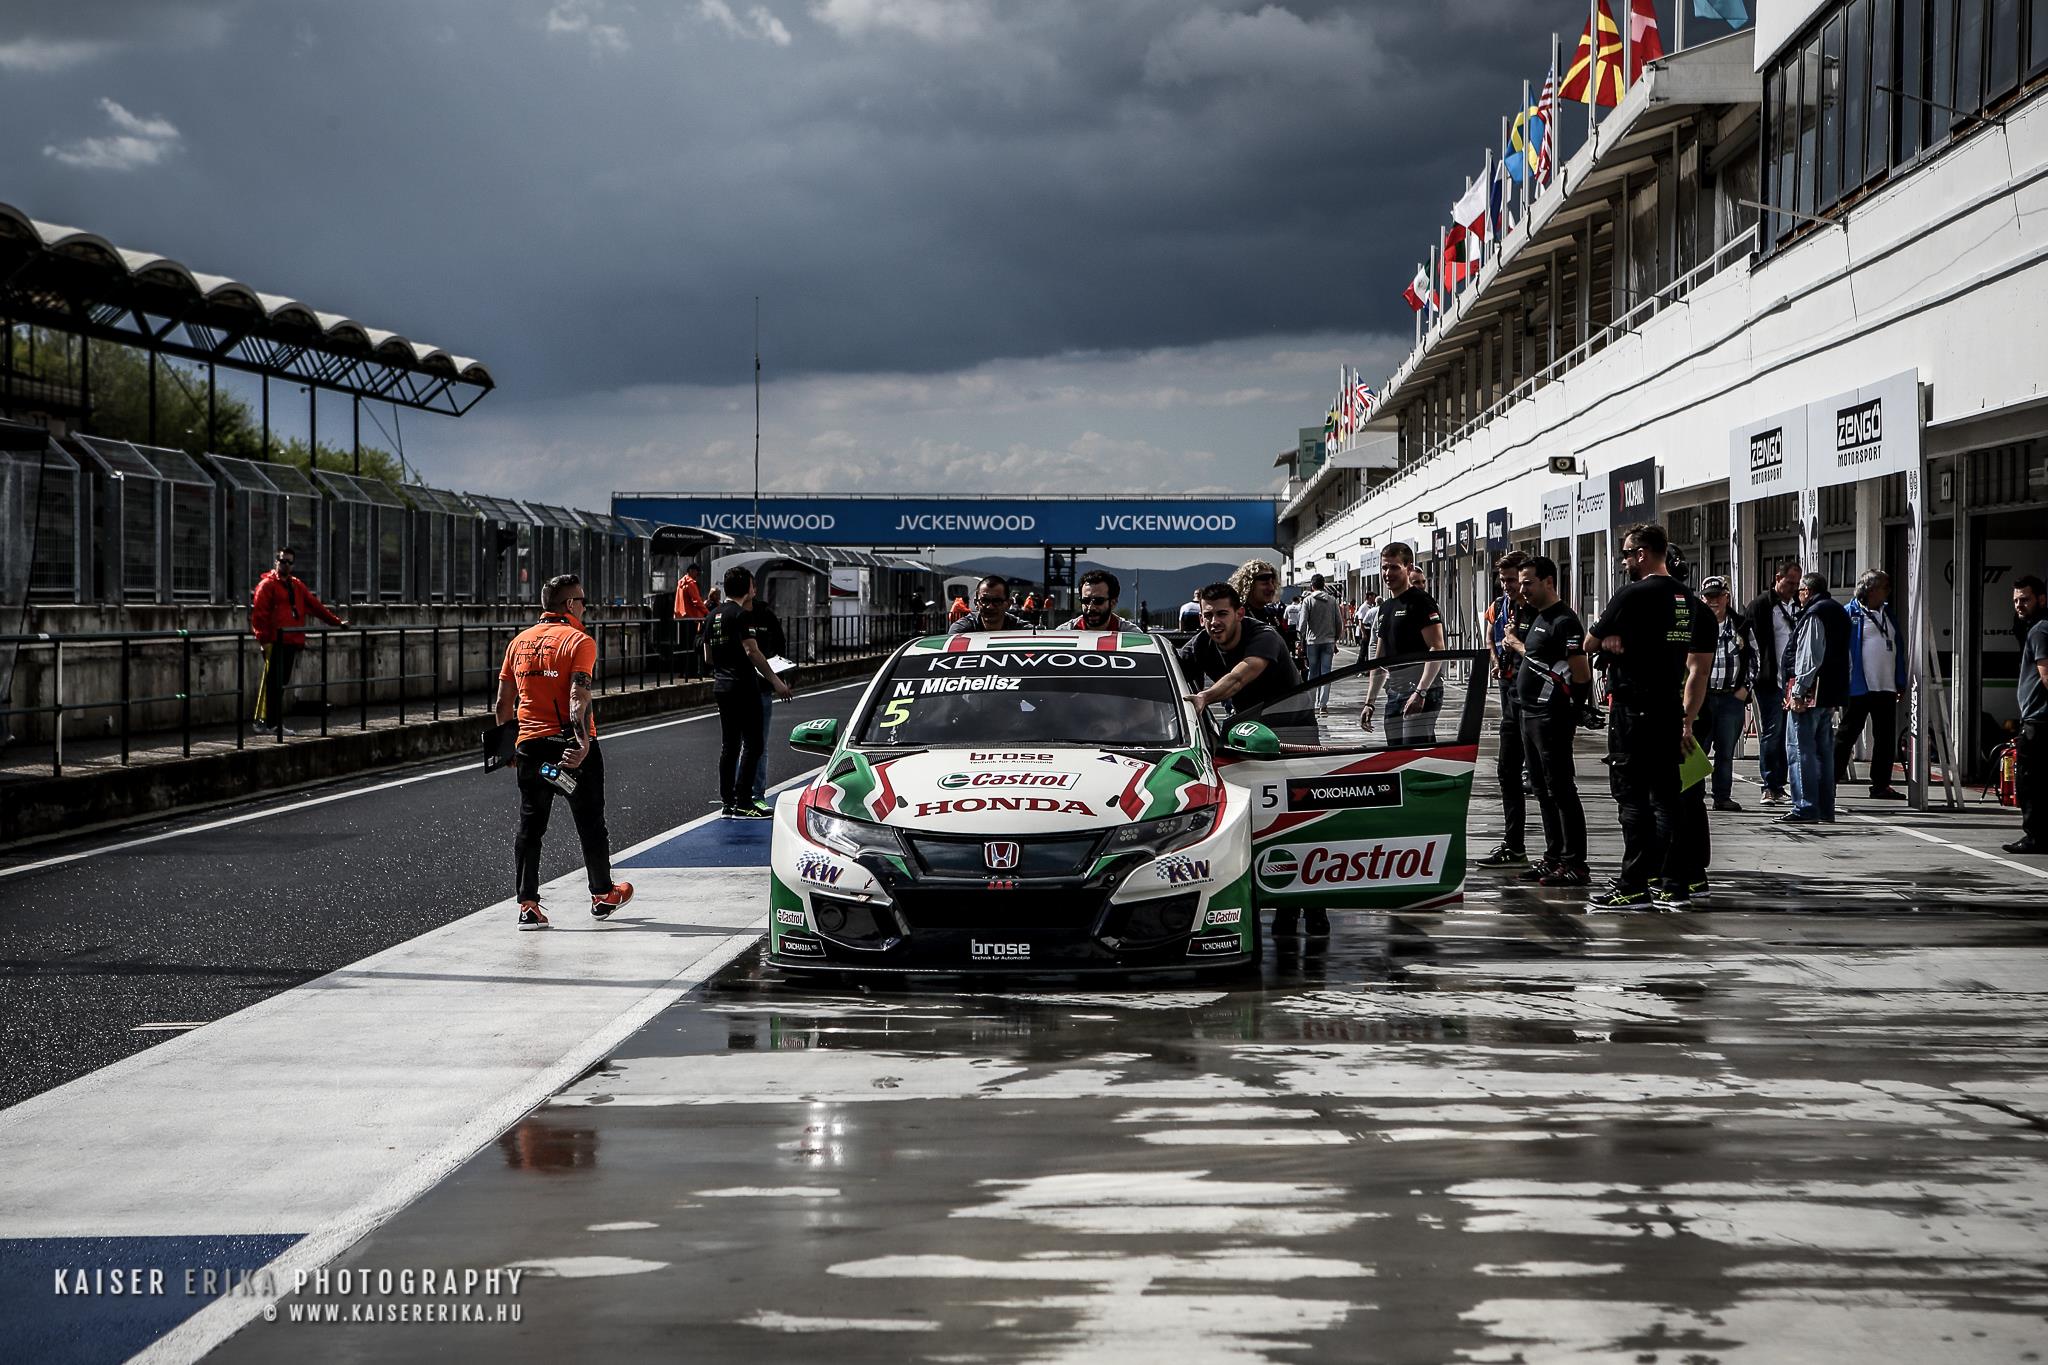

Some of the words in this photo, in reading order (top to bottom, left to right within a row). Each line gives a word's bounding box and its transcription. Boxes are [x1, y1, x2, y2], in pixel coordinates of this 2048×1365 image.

[1838, 445, 1881, 467] MOTORSPORT
[1751, 467, 1782, 485] MOTORSPORT
[700, 514, 835, 531] JVCKENWOOD
[895, 514, 1035, 531] JVCKENWOOD
[1095, 514, 1237, 531] JVCKENWOOD
[927, 653, 1137, 671] KENWOOD
[893, 681, 915, 697] N.
[920, 675, 1022, 694] Michelisz
[880, 698, 914, 728] 5
[970, 752, 1054, 760] brose
[971, 773, 1069, 787] Castrol
[1262, 784, 1279, 808] 5
[1310, 785, 1375, 799] YOKOHAMA
[914, 797, 1098, 817] HONDA
[1167, 859, 1211, 883] KW
[1301, 841, 1436, 885] Castrol
[802, 860, 844, 885] KW
[782, 911, 803, 924] Castrol
[1215, 910, 1239, 922] Castrol
[785, 942, 812, 951] YOKOHAMA
[971, 939, 1030, 955] brose
[1202, 941, 1232, 950] YOKOHAMA
